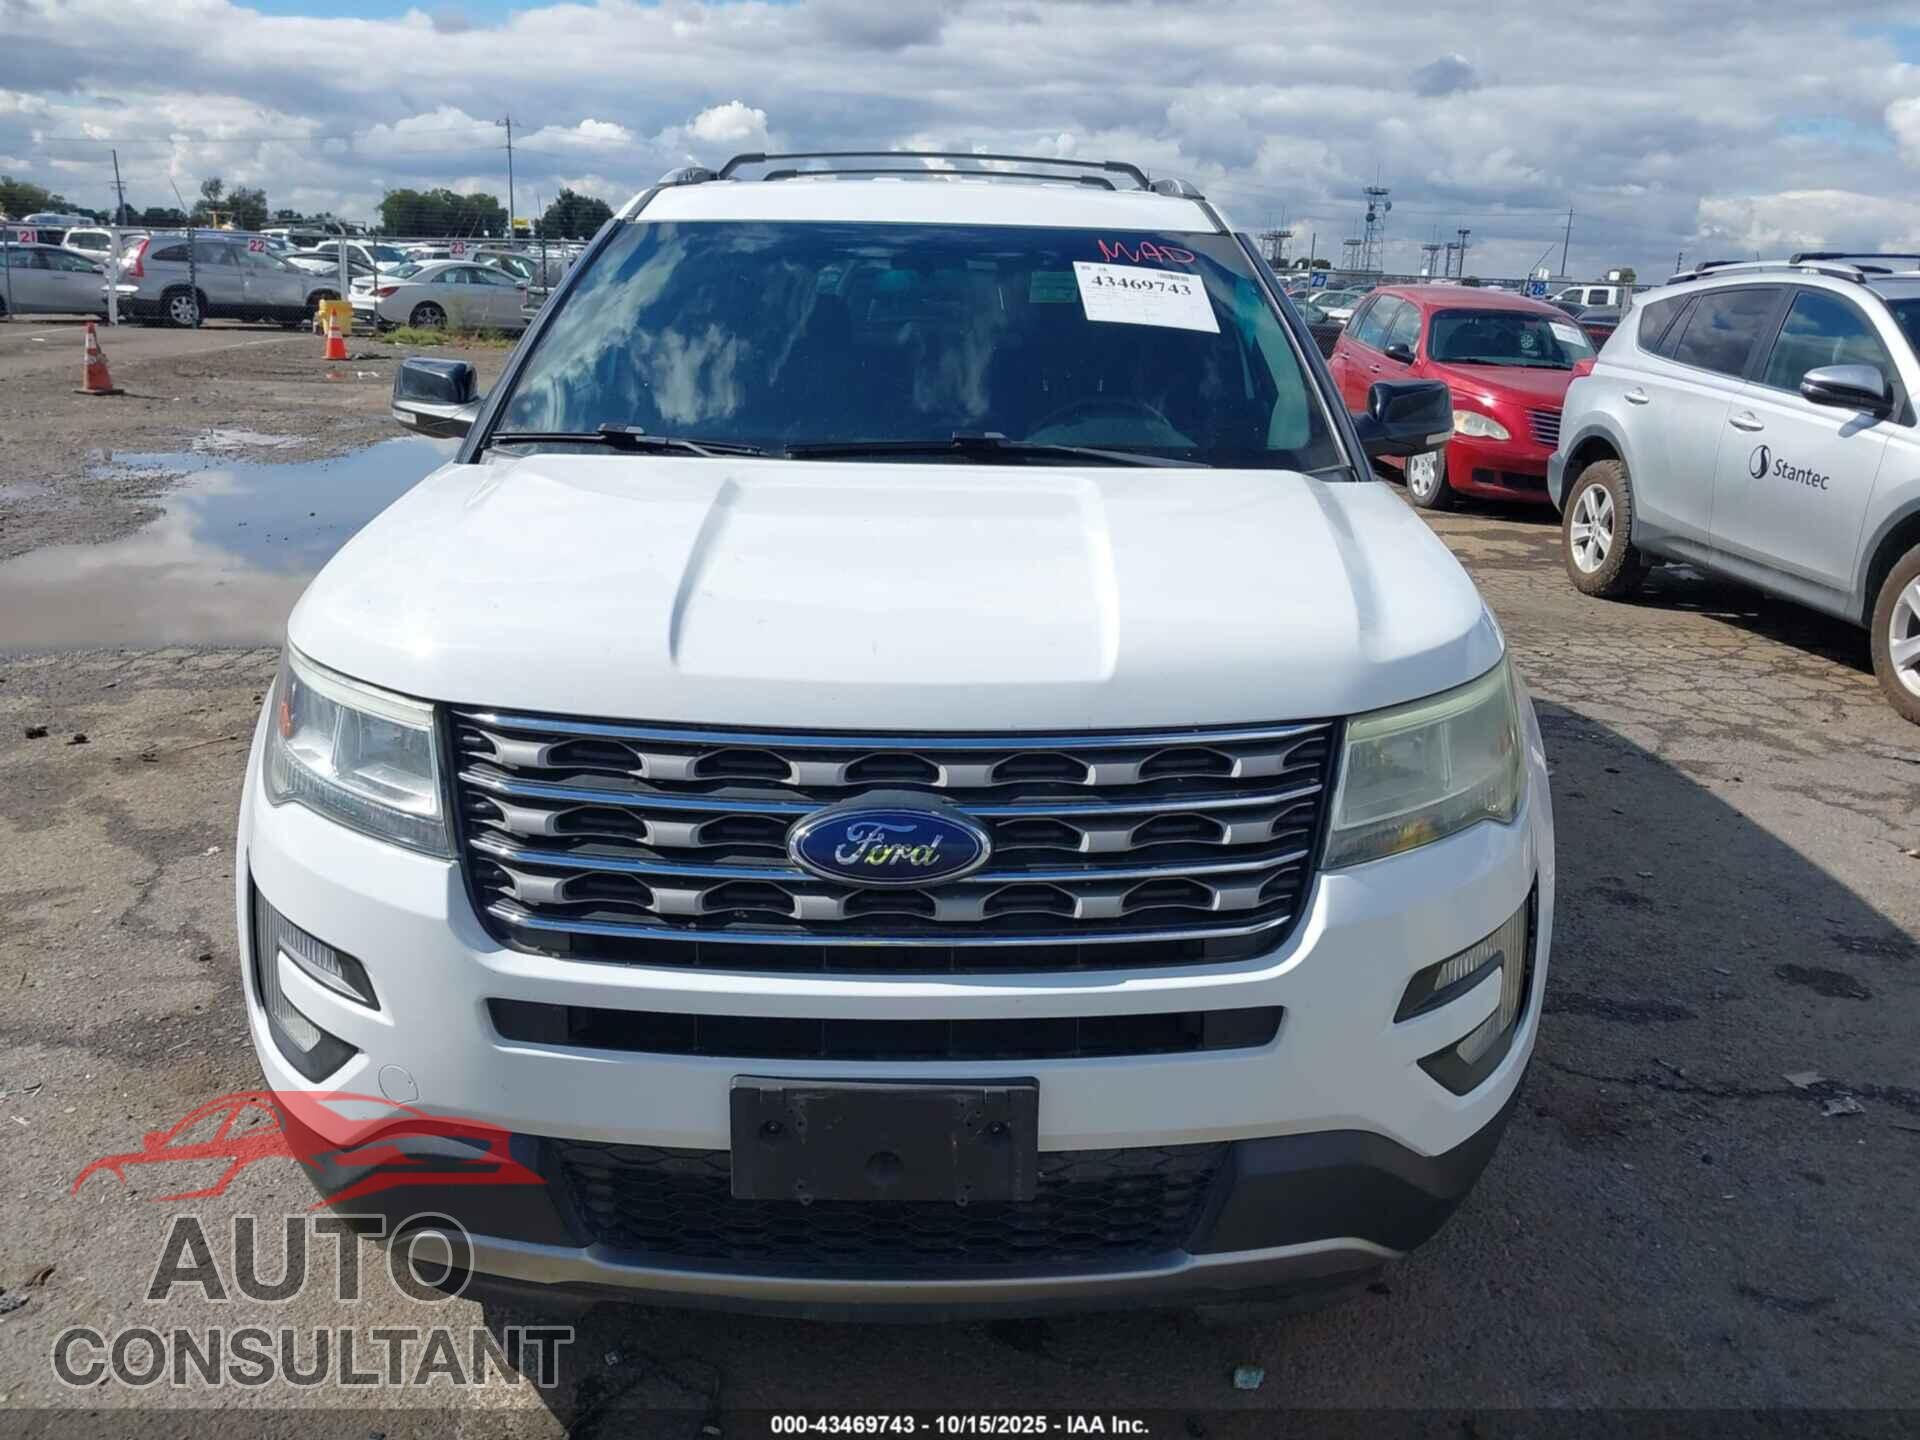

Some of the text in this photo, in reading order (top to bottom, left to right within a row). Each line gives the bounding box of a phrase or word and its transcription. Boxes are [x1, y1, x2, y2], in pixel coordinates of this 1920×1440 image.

[19, 230, 36, 243] 21
[249, 239, 265, 252] 22
[451, 241, 465, 254] 23
[1091, 275, 1192, 296] 43469743
[1531, 281, 1547, 296] 28
[1773, 458, 1830, 490] Stantec
[834, 821, 943, 866] Ford
